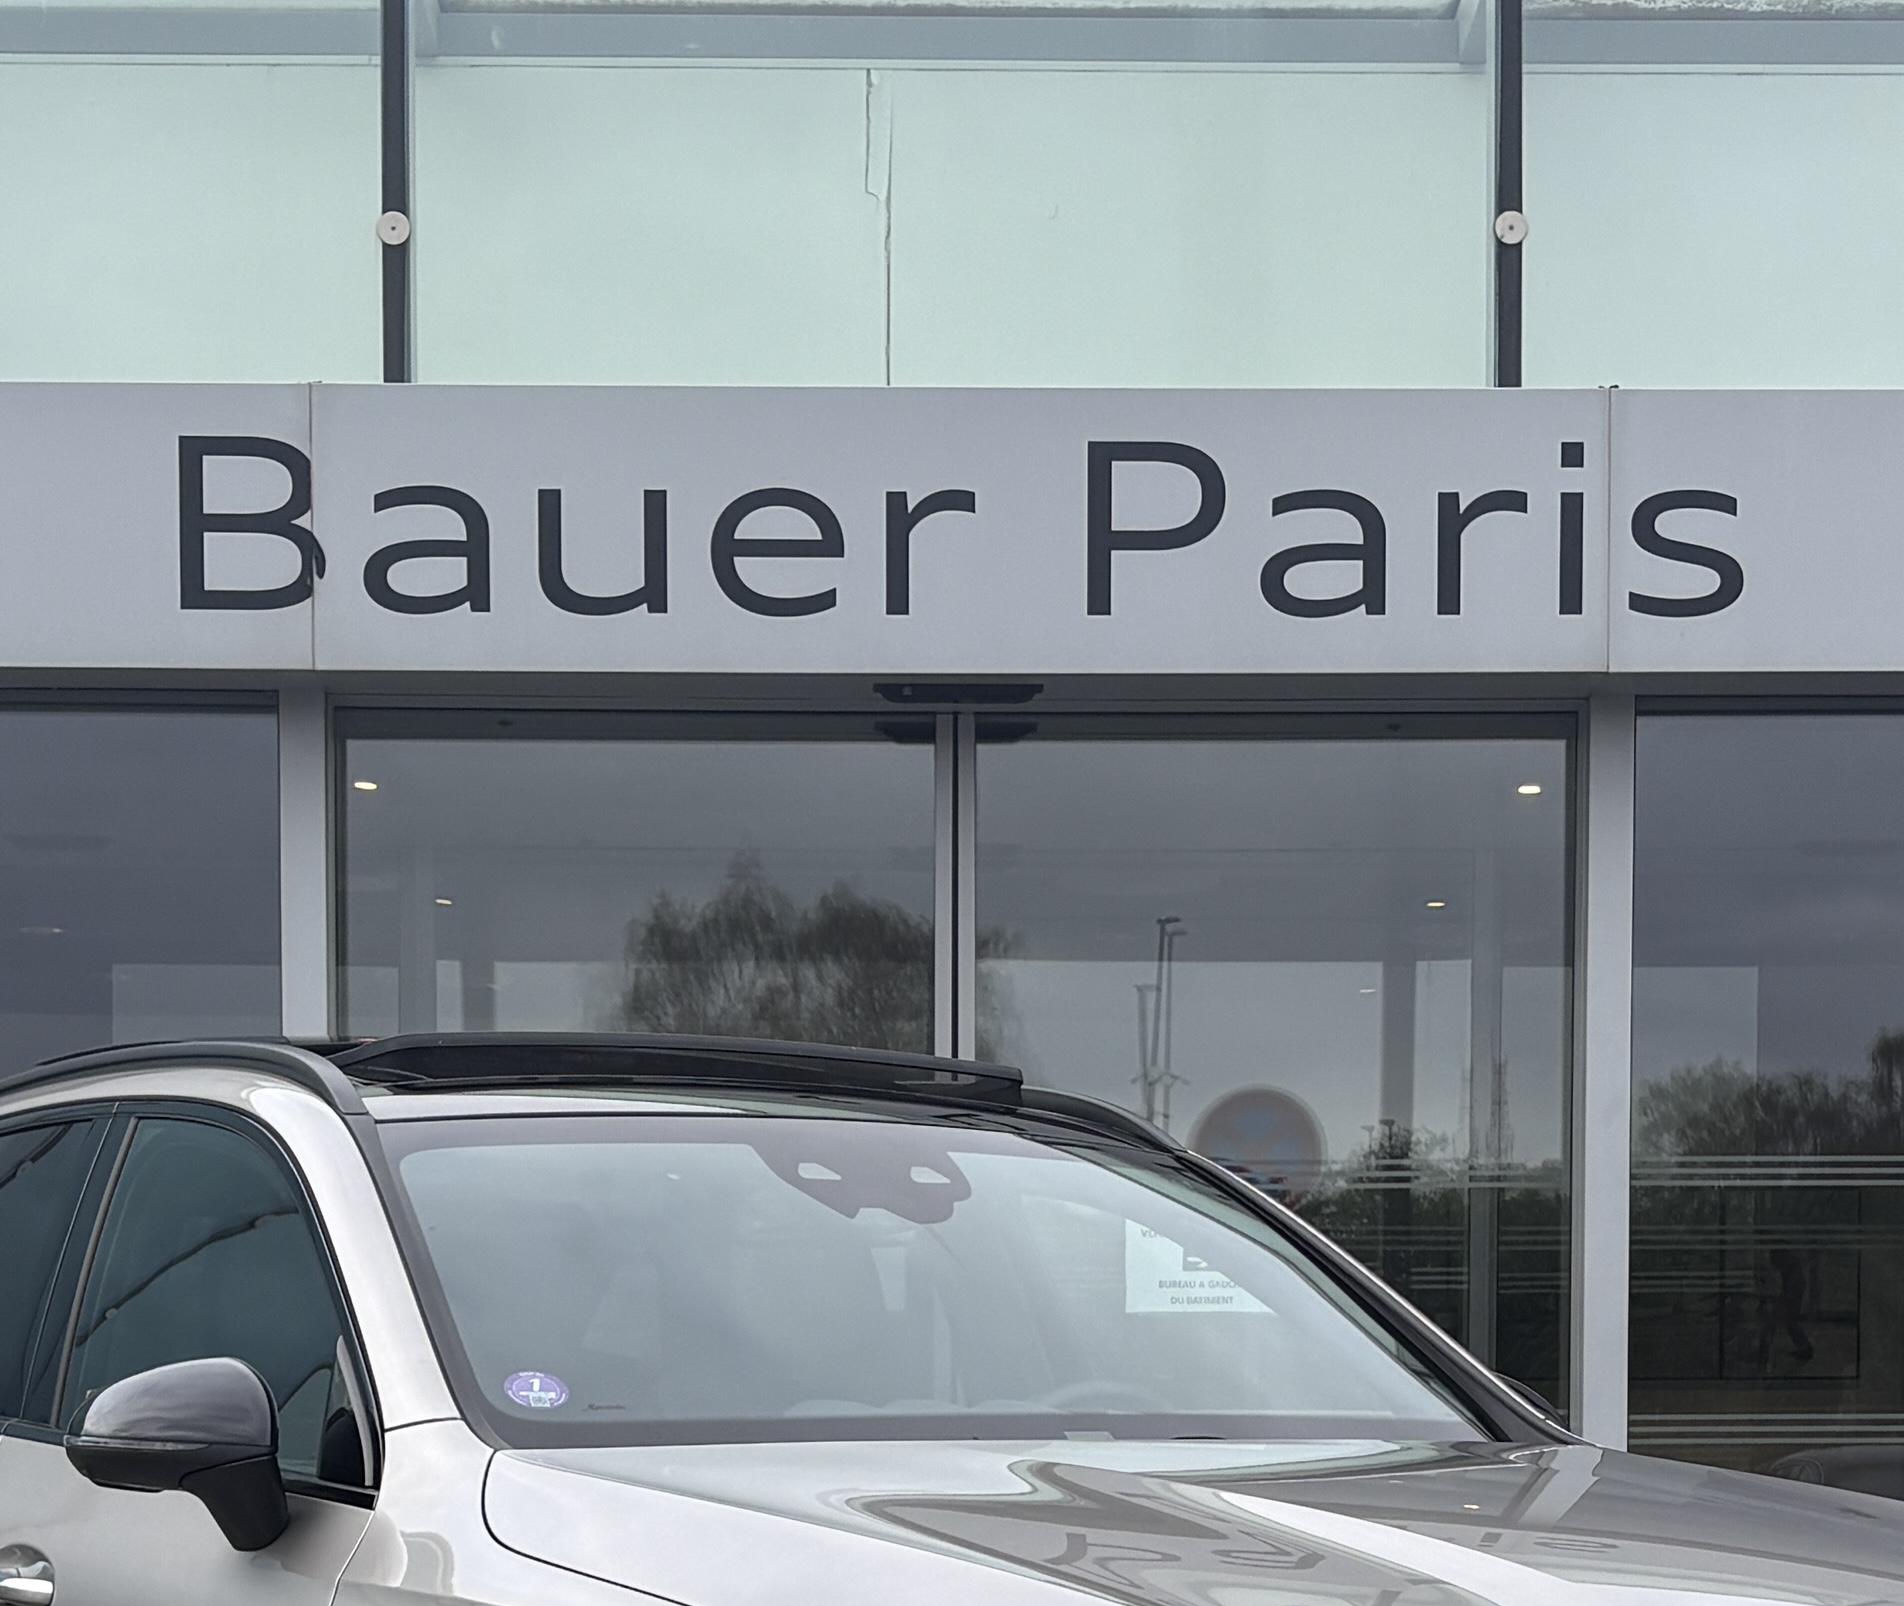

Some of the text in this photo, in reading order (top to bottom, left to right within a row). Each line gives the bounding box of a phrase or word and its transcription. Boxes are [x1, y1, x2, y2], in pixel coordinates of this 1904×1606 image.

[178, 435, 1744, 619] Bauer Paris
[529, 1378, 541, 1392] 1
